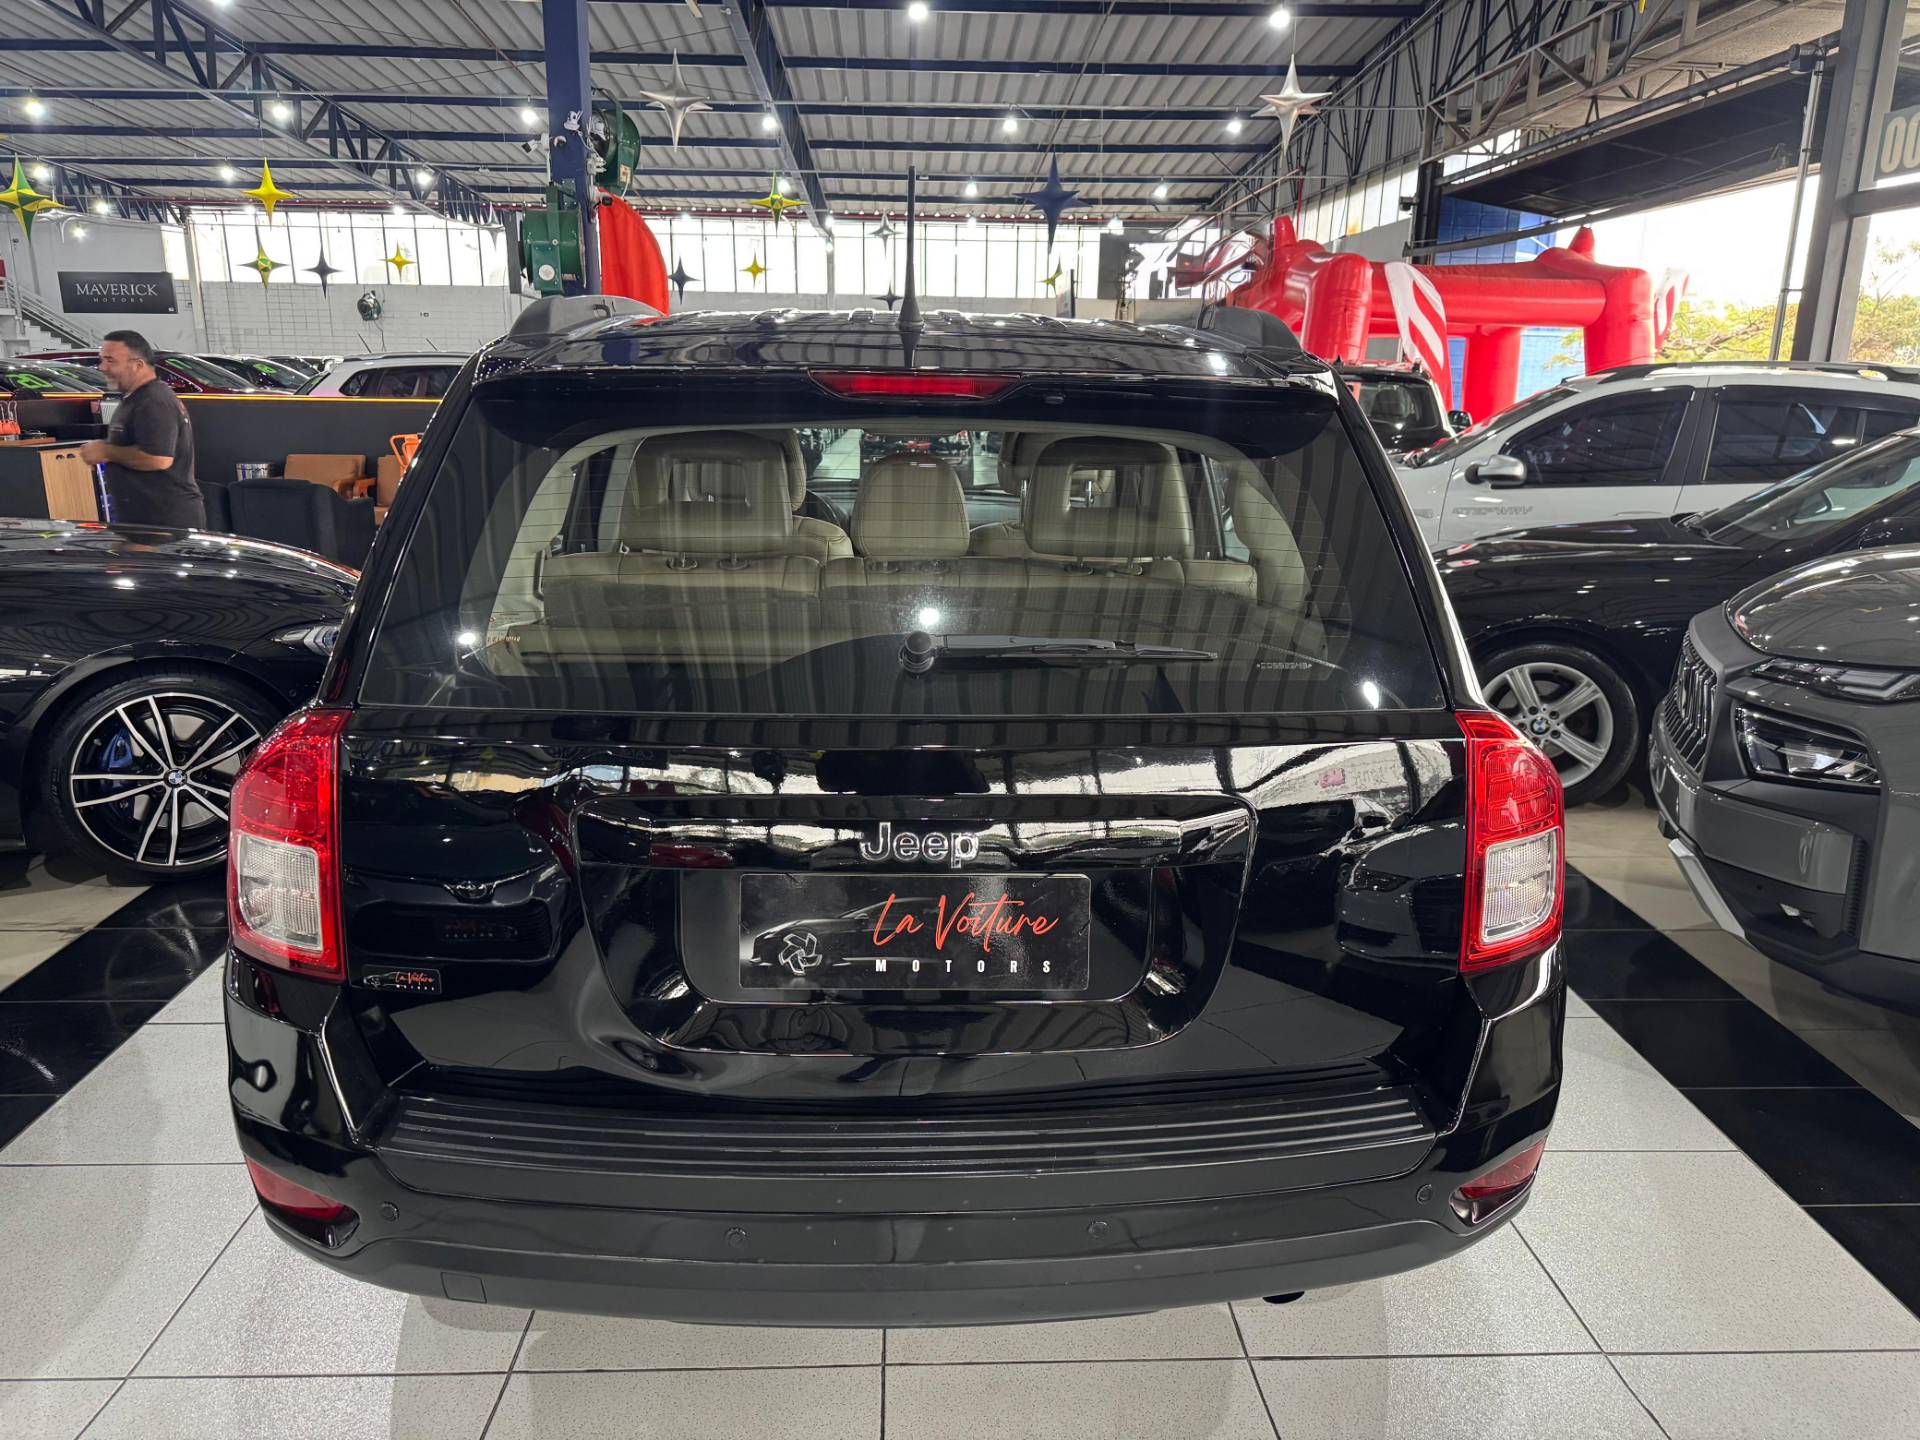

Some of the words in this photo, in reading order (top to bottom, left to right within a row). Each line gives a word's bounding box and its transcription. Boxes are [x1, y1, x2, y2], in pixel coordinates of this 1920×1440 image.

[75, 283, 158, 296] MAVERICK
[859, 821, 980, 869] Jeep
[873, 892, 925, 946] La
[934, 891, 1060, 953] Voiture
[875, 959, 1052, 973] MOTORS
